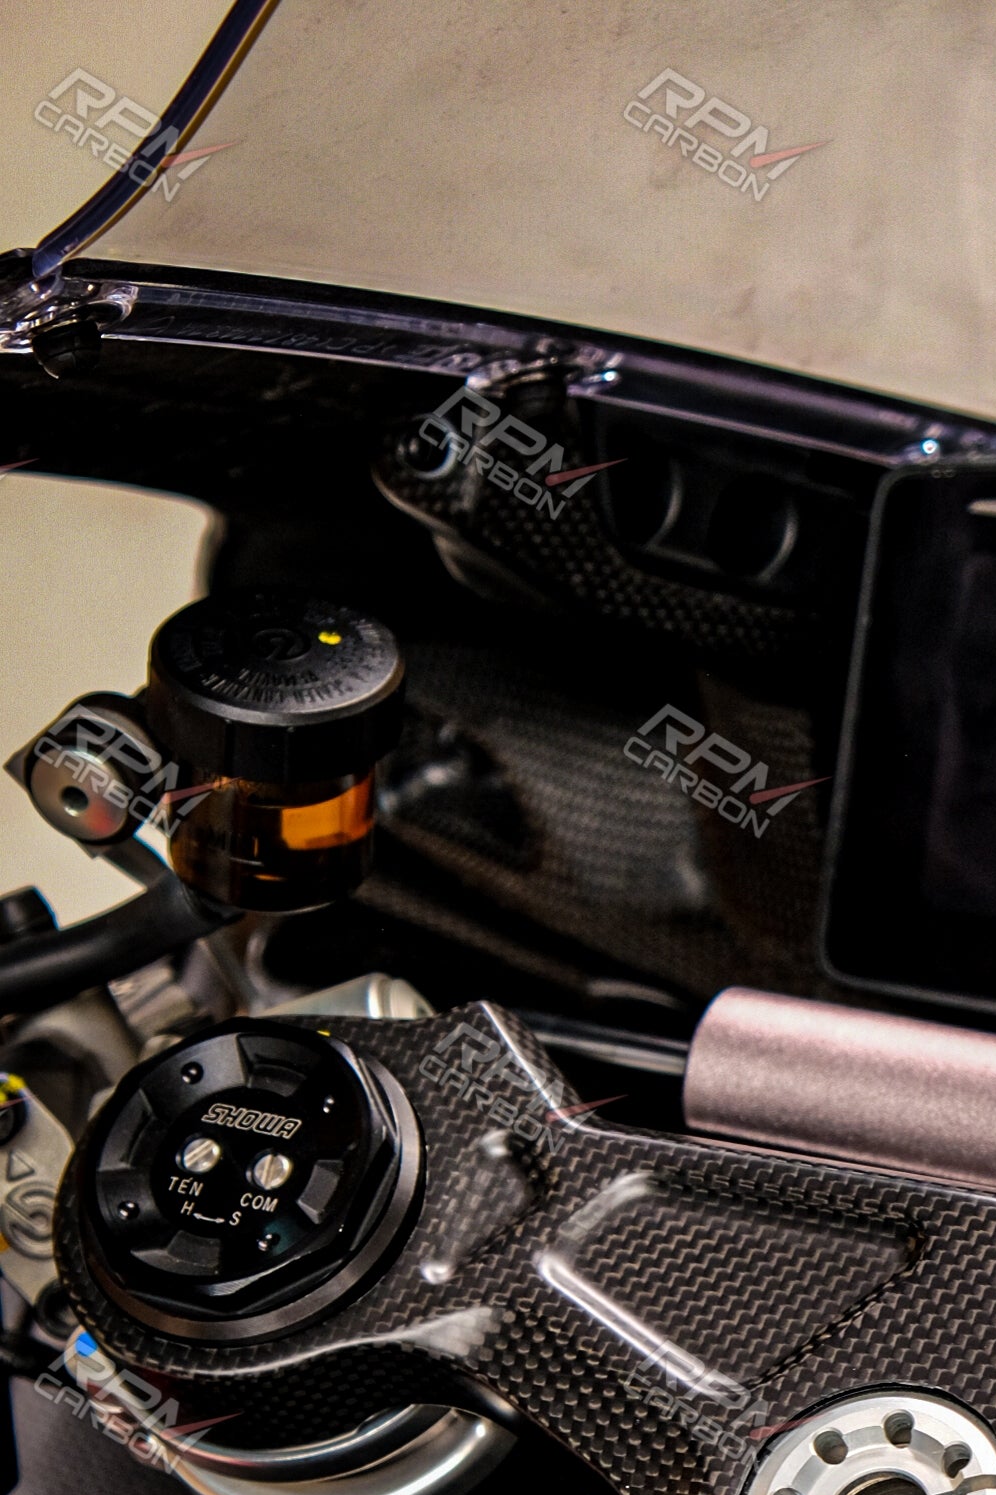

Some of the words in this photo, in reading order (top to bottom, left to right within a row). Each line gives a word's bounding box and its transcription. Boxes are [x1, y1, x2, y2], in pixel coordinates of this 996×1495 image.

[201, 1103, 302, 1139] SHOWA
[167, 1176, 204, 1198] TEN
[240, 1192, 279, 1213] COM
[180, 1201, 195, 1217] H
[228, 1210, 242, 1227] S
